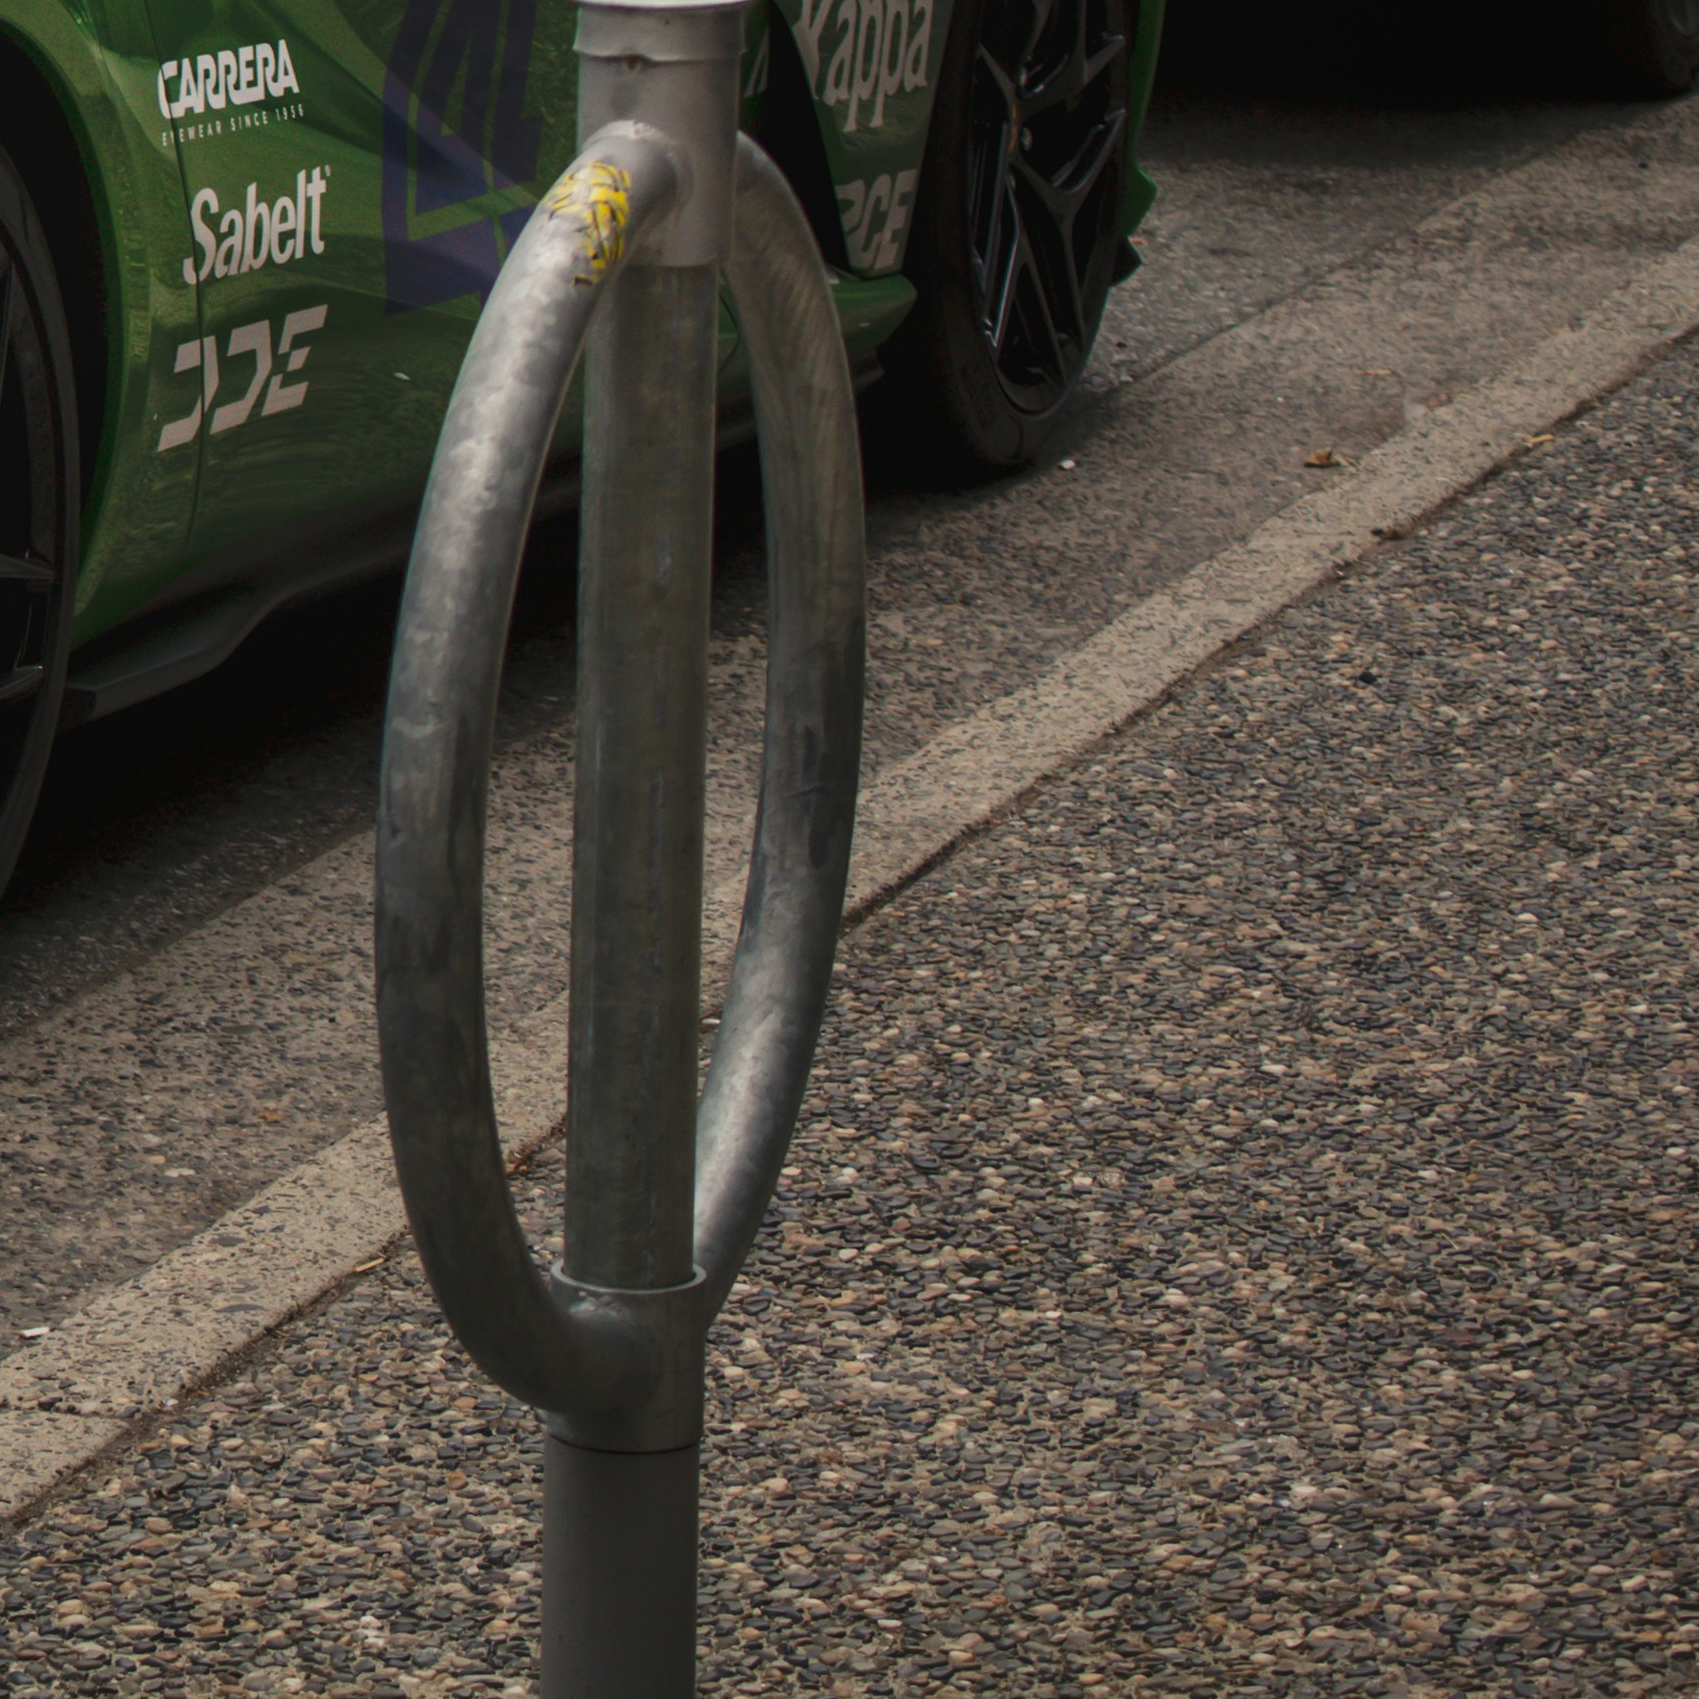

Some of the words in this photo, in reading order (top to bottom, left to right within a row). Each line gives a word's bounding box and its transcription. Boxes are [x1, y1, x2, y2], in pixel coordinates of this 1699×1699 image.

[157, 39, 300, 119] CARRERA
[162, 120, 223, 147] EYEWEAR
[230, 110, 269, 133] SINCE
[275, 103, 304, 122] 1956
[182, 166, 328, 286] Sabelt
